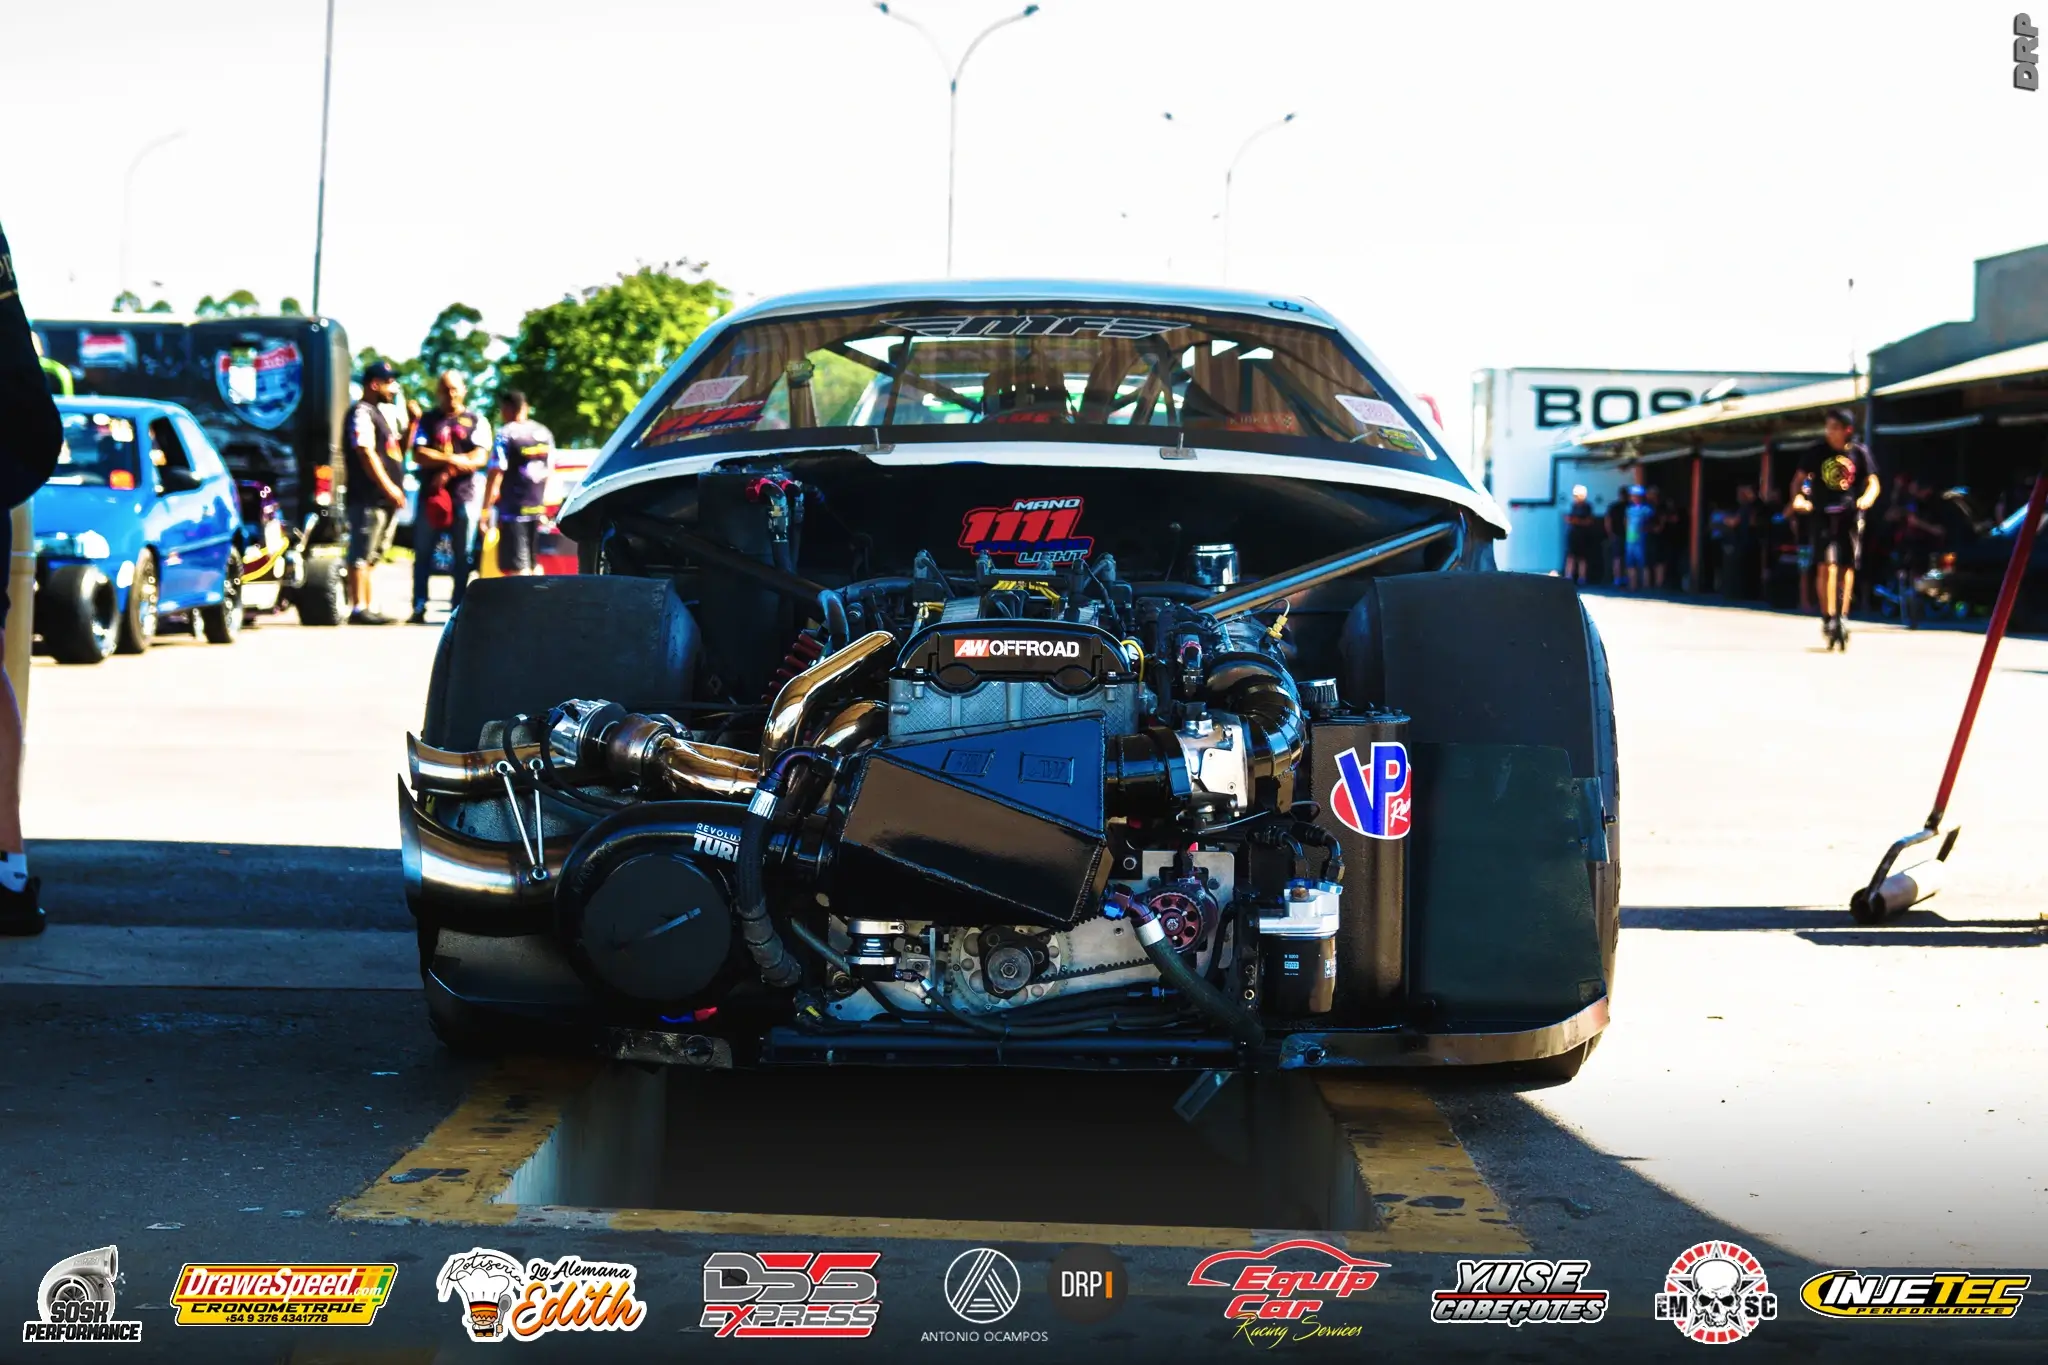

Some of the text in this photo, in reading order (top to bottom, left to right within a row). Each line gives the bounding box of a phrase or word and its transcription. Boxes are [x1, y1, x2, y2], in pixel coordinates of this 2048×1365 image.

[1534, 385, 1747, 429] BOS
[1014, 499, 1081, 511] MANO
[964, 509, 1078, 543] 1111
[1018, 550, 1088, 563] LIGHT
[955, 640, 1080, 658] AW OFFROAD
[1334, 742, 1409, 837] VP
